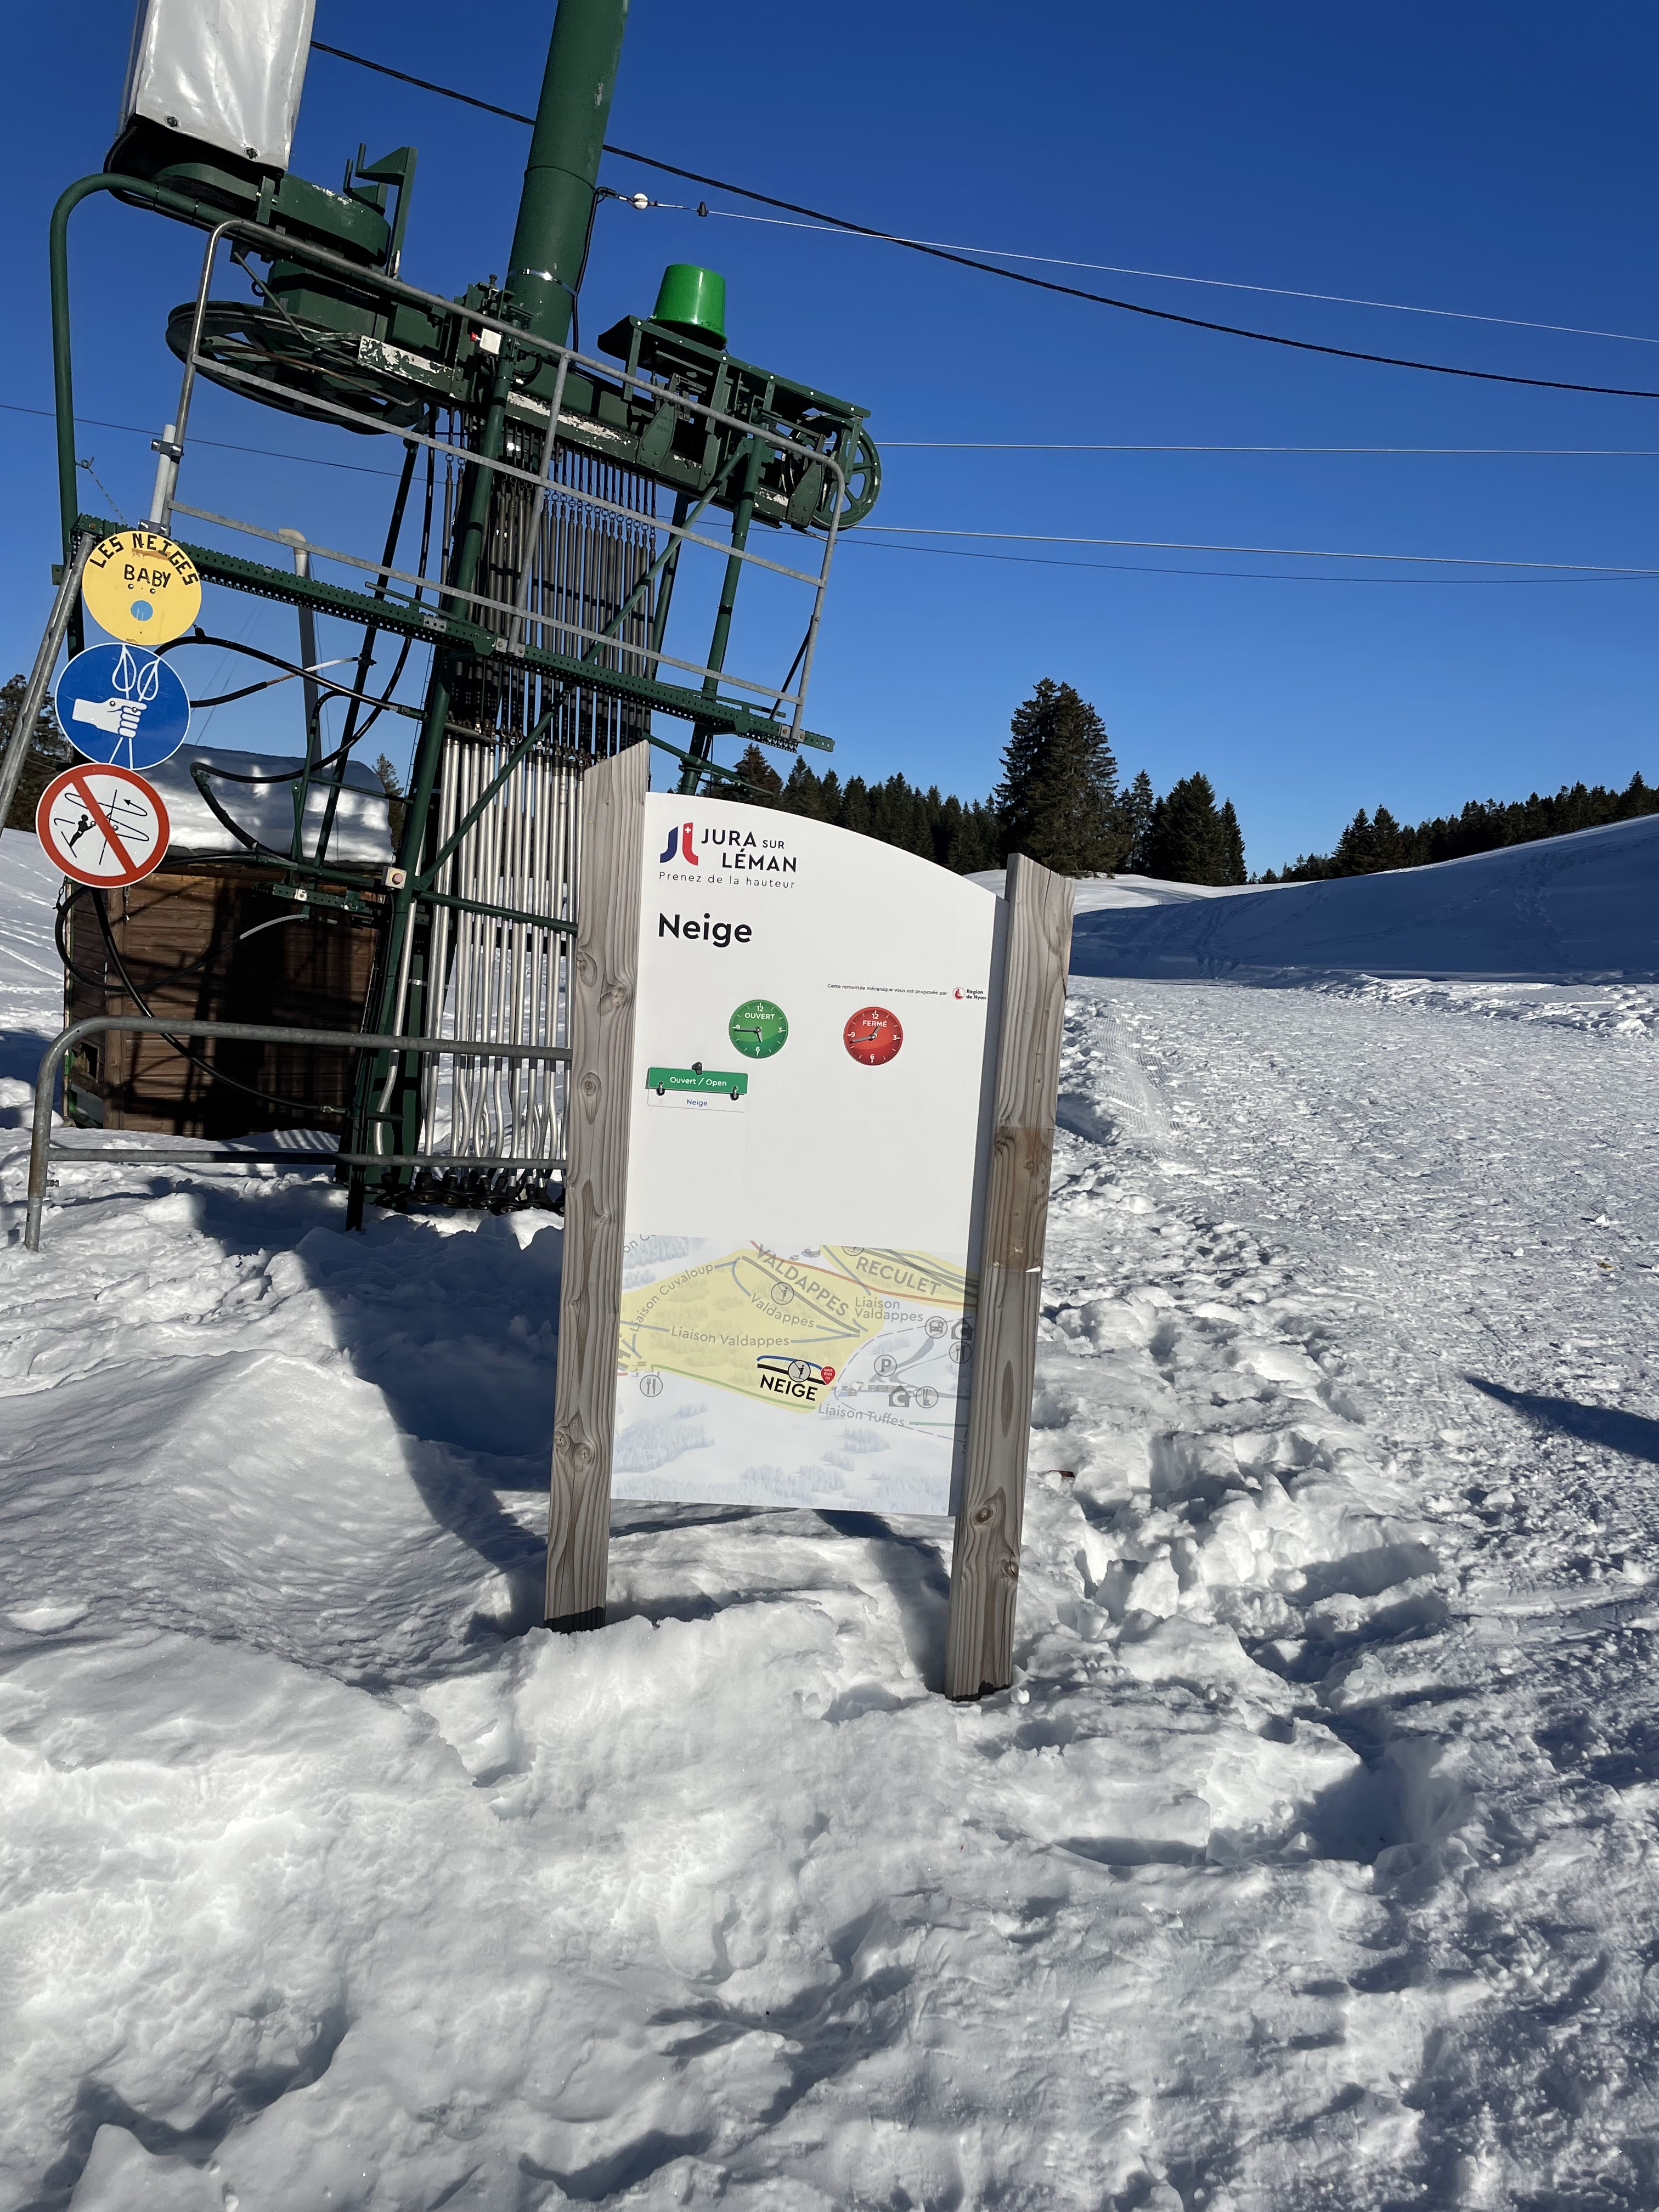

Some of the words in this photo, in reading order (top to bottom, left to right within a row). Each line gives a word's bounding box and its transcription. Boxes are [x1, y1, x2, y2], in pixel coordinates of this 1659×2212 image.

[89, 536, 124, 568] LES
[132, 533, 199, 585] NEIGES
[124, 564, 171, 588] BABY
[701, 828, 757, 847] JURA
[763, 840, 785, 849] SUR
[722, 848, 797, 873] LÉMAN
[659, 871, 702, 882] Prenez
[708, 874, 723, 884] de
[730, 876, 739, 885] la
[746, 877, 795, 889] hauteur
[658, 912, 752, 948] Neige
[669, 1076, 696, 1085] Ouvert
[698, 1077, 704, 1086] /
[706, 1079, 727, 1087] Open
[758, 1244, 849, 1316] VALDAPPES
[855, 1256, 941, 1296] RECULET
[629, 1295, 660, 1332] Liaison
[659, 1264, 713, 1295] Cuvaloup
[855, 1296, 900, 1310] Liaison
[752, 1293, 815, 1328] Valdappes
[855, 1307, 923, 1323] Valdappes
[671, 1326, 716, 1344] Liaison
[720, 1334, 789, 1348] Valdappes
[881, 1358, 891, 1372] P
[760, 1374, 818, 1401] NEIGE
[818, 1403, 862, 1420] Liaison
[867, 1410, 905, 1427] Tuffes
